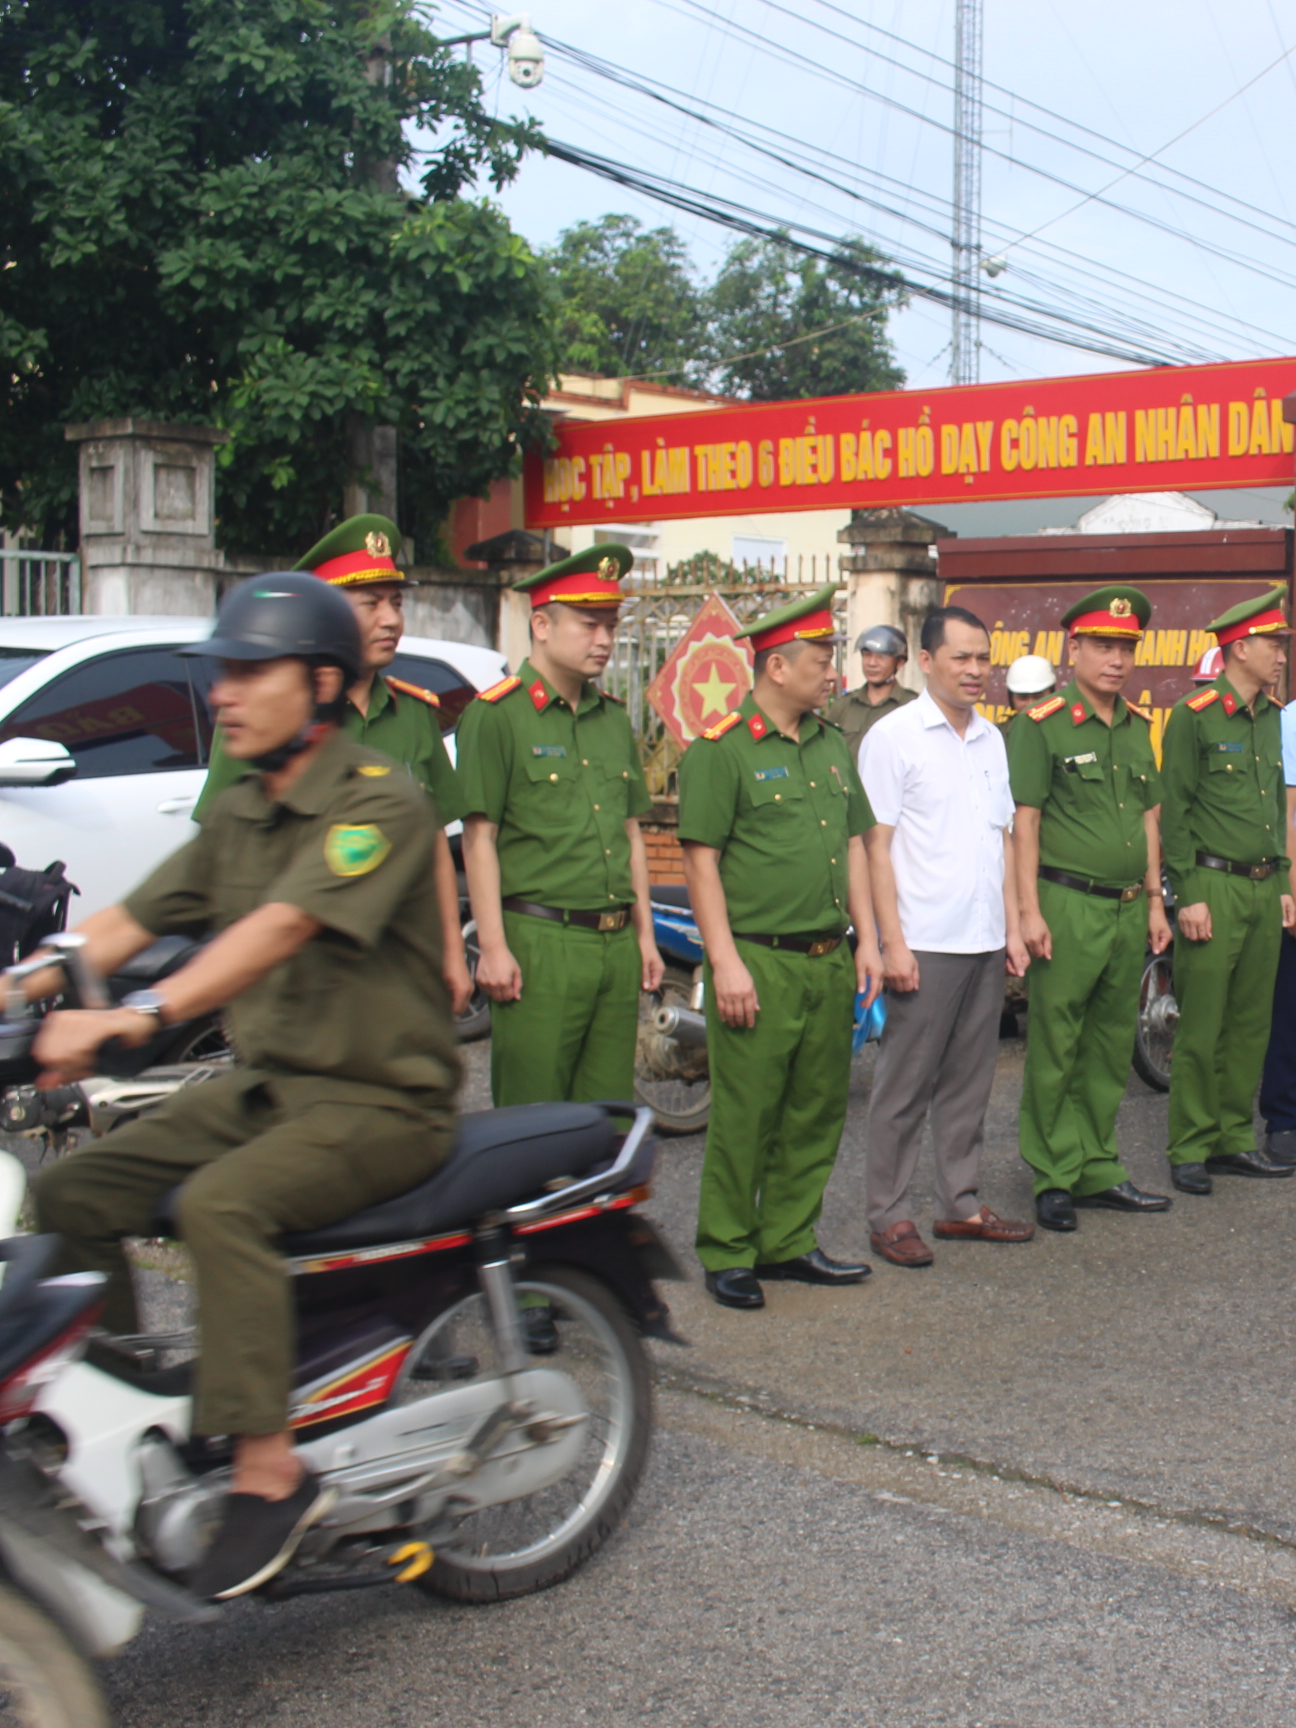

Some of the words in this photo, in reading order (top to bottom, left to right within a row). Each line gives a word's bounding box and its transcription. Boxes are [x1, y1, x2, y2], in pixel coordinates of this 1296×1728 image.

[640, 437, 690, 497] LÀM
[694, 440, 752, 492] THEO
[757, 439, 774, 488] 6
[778, 415, 835, 487] ĐIỀU
[839, 419, 892, 483] BÁC
[897, 405, 935, 478] HỒ
[940, 420, 995, 485] DẠY
[1000, 405, 1079, 472] CÔNG
[1084, 410, 1128, 466] AN
[1134, 392, 1221, 464] NHÂN
[1228, 386, 1294, 457] DÂN
[989, 620, 1031, 667] ÔNG
[1032, 630, 1065, 667] AN
